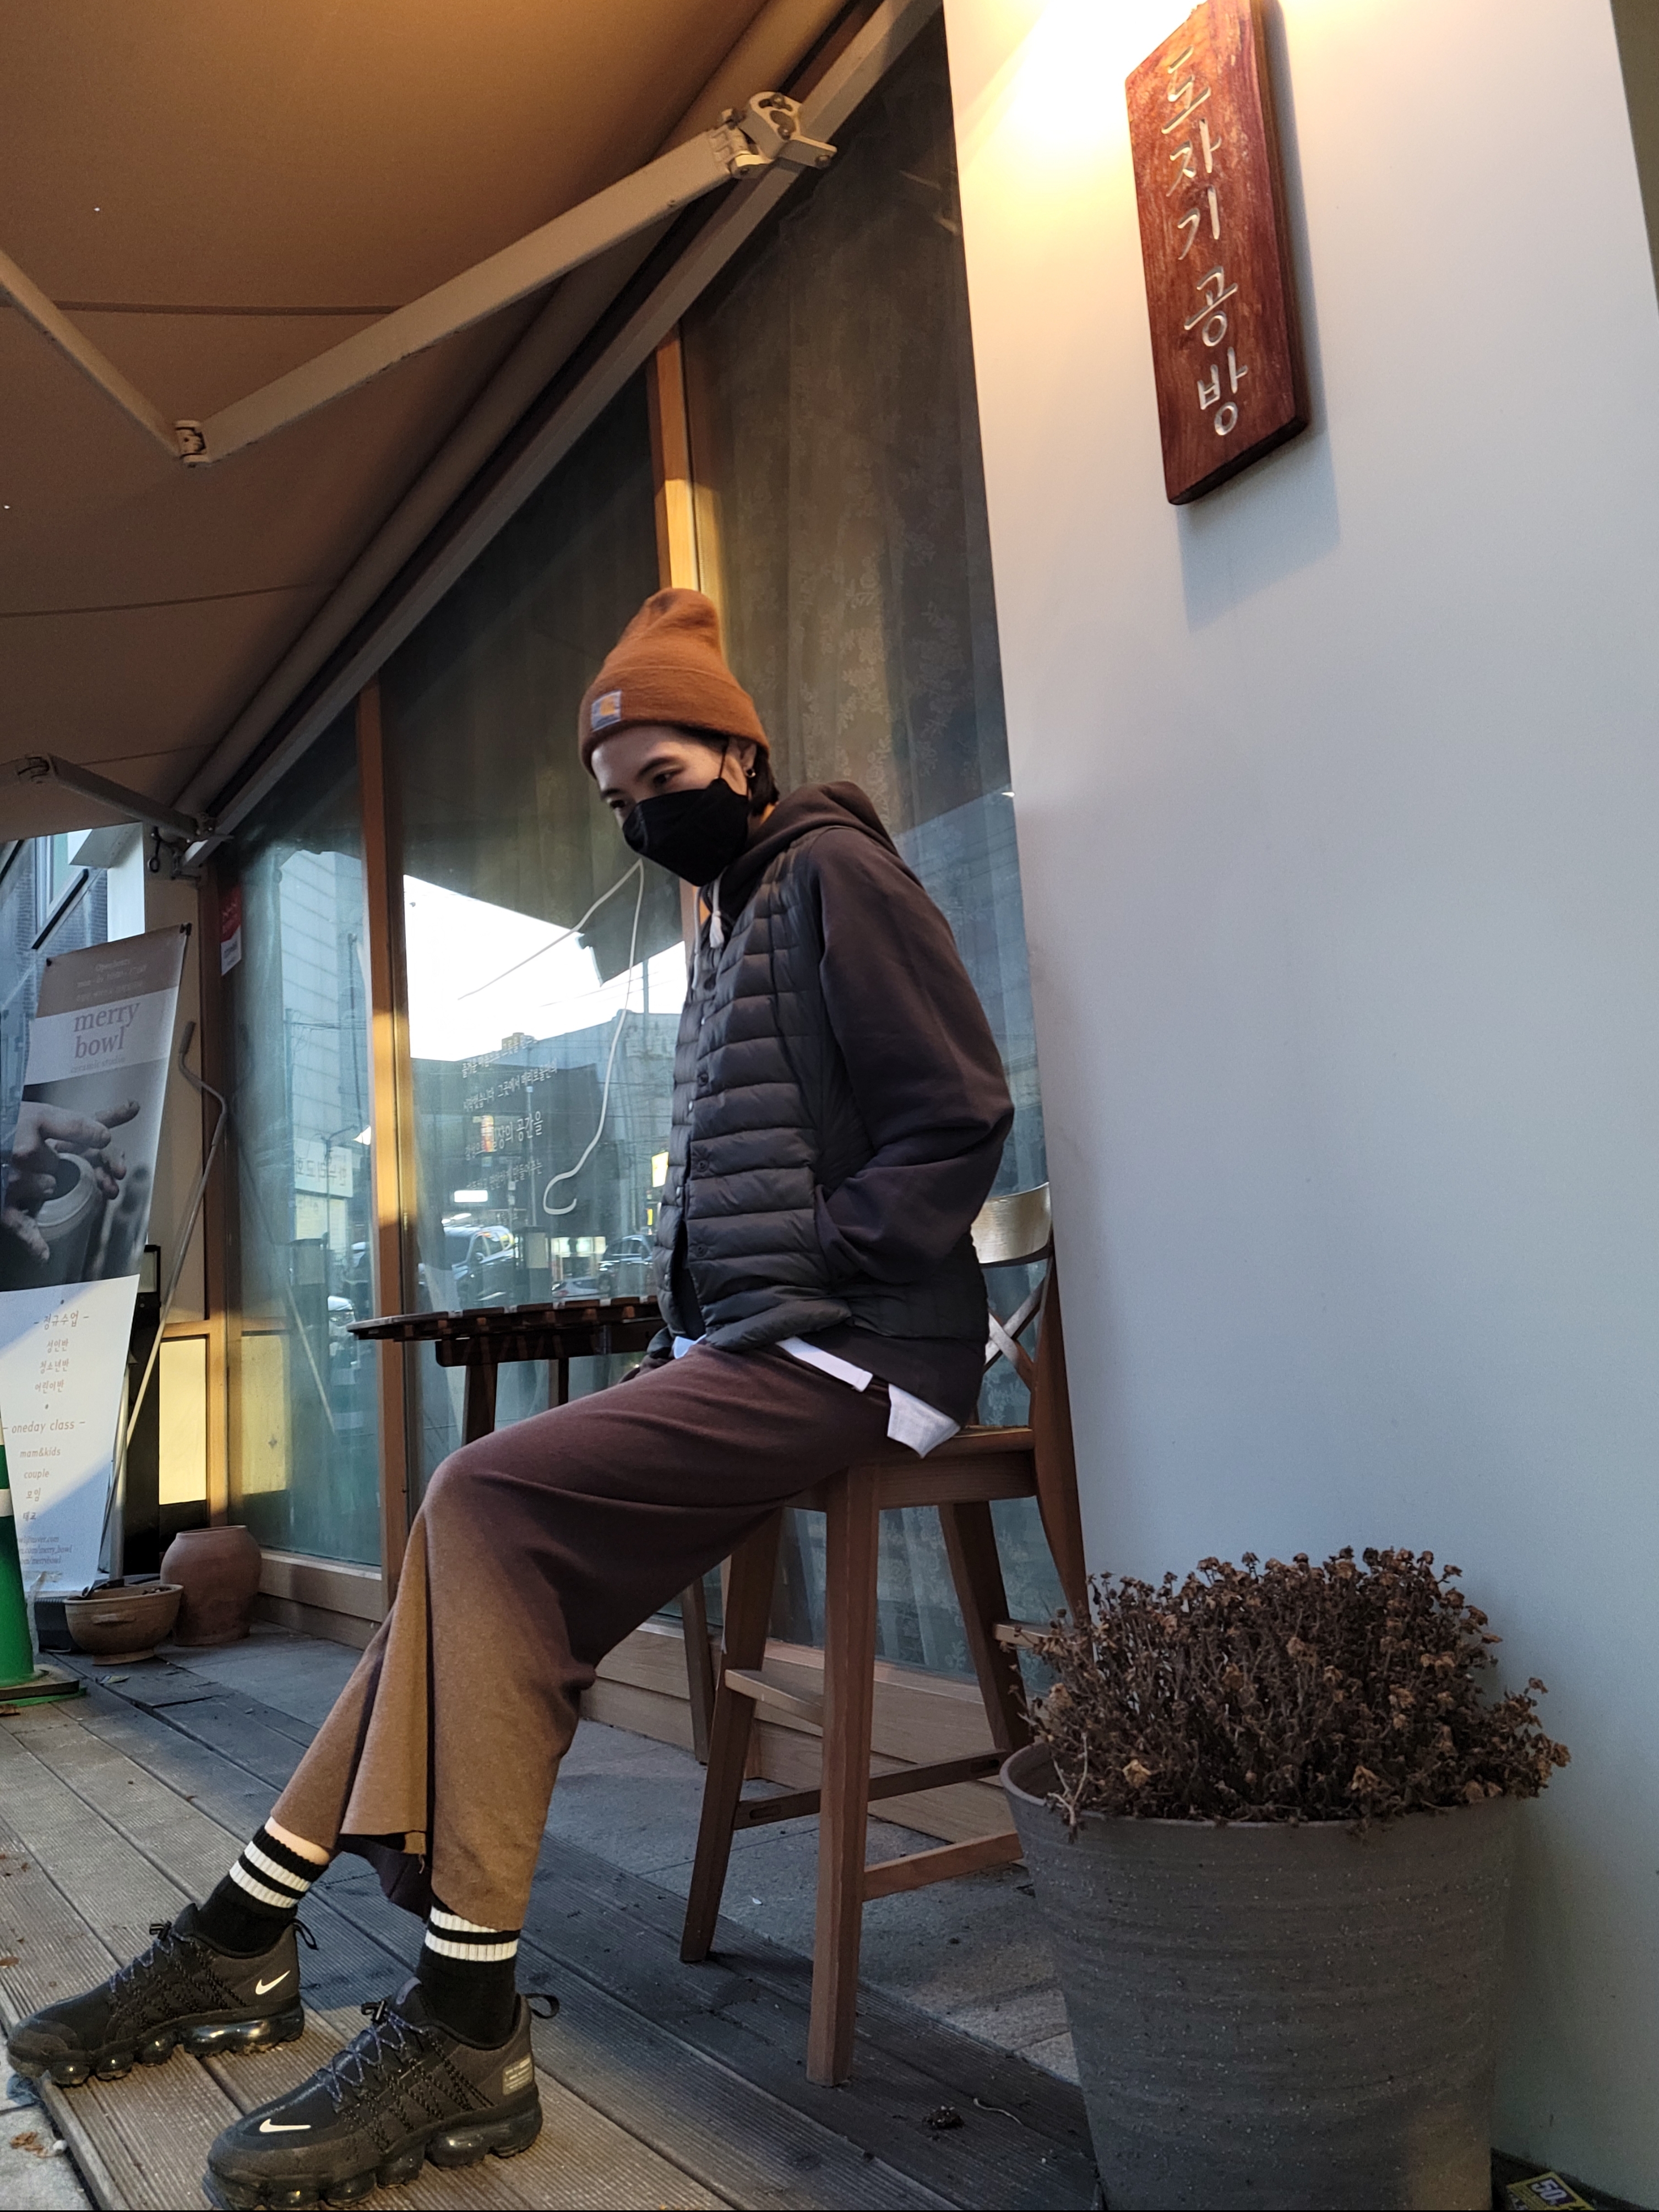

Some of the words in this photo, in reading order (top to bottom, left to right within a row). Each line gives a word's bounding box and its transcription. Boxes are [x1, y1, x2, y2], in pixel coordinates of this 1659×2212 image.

[74, 1003, 140, 1032] merry
[75, 1026, 124, 1058] bowl
[516, 1111, 543, 1142] 공간을
[43, 1310, 79, 1330] 정규수업
[47, 1338, 69, 1354] 성인반
[40, 1358, 69, 1374] 청소년반
[35, 1379, 64, 1394] 어린이반
[12, 1420, 46, 1434] oneday
[50, 1418, 75, 1431] class
[20, 1447, 61, 1458] mam&kids
[24, 1468, 50, 1480] couple
[26, 1487, 41, 1502] 모임
